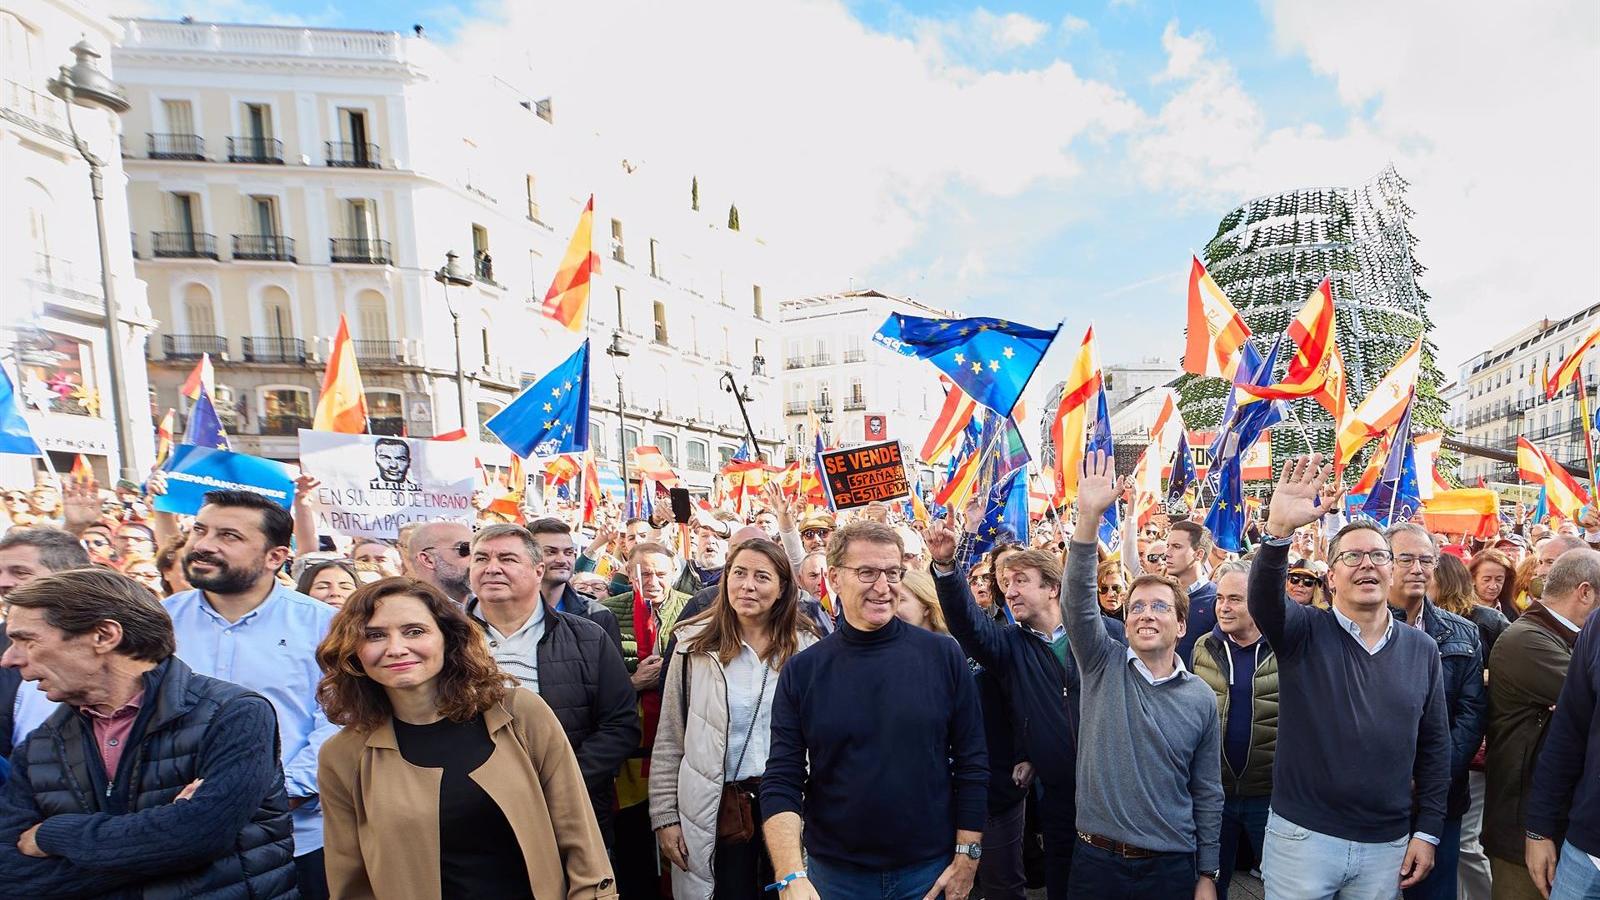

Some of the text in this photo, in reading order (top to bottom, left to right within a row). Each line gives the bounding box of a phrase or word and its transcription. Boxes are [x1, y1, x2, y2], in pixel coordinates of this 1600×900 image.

[824, 455, 847, 475] SE
[848, 444, 900, 470] VENDE
[849, 470, 893, 489] ESPAÑA
[318, 488, 341, 506] EN
[425, 491, 468, 510] ENGAÑO
[331, 512, 382, 531] PATRIA
